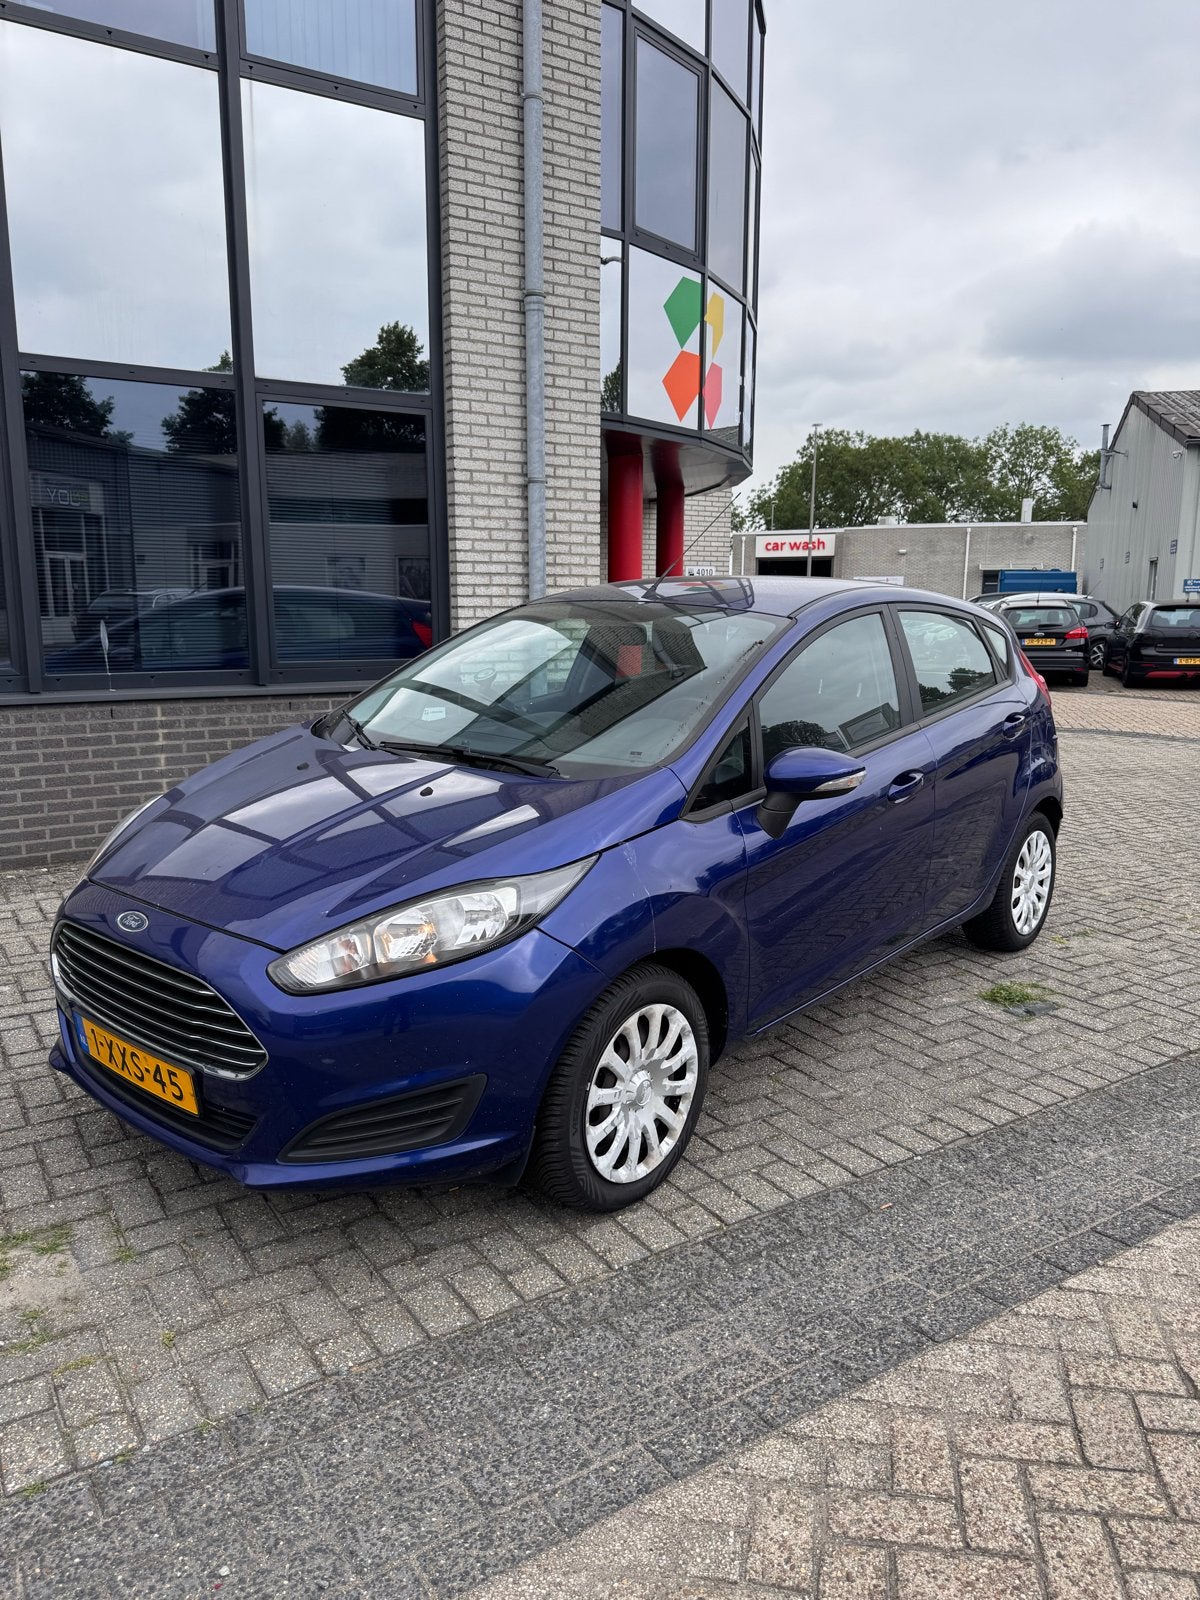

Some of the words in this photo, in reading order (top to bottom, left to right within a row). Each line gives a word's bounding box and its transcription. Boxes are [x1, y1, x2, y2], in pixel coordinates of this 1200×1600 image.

[765, 540, 786, 551] car
[789, 537, 826, 551] wash
[696, 568, 713, 576] 4010
[90, 1027, 184, 1101] 1-XXS-45
